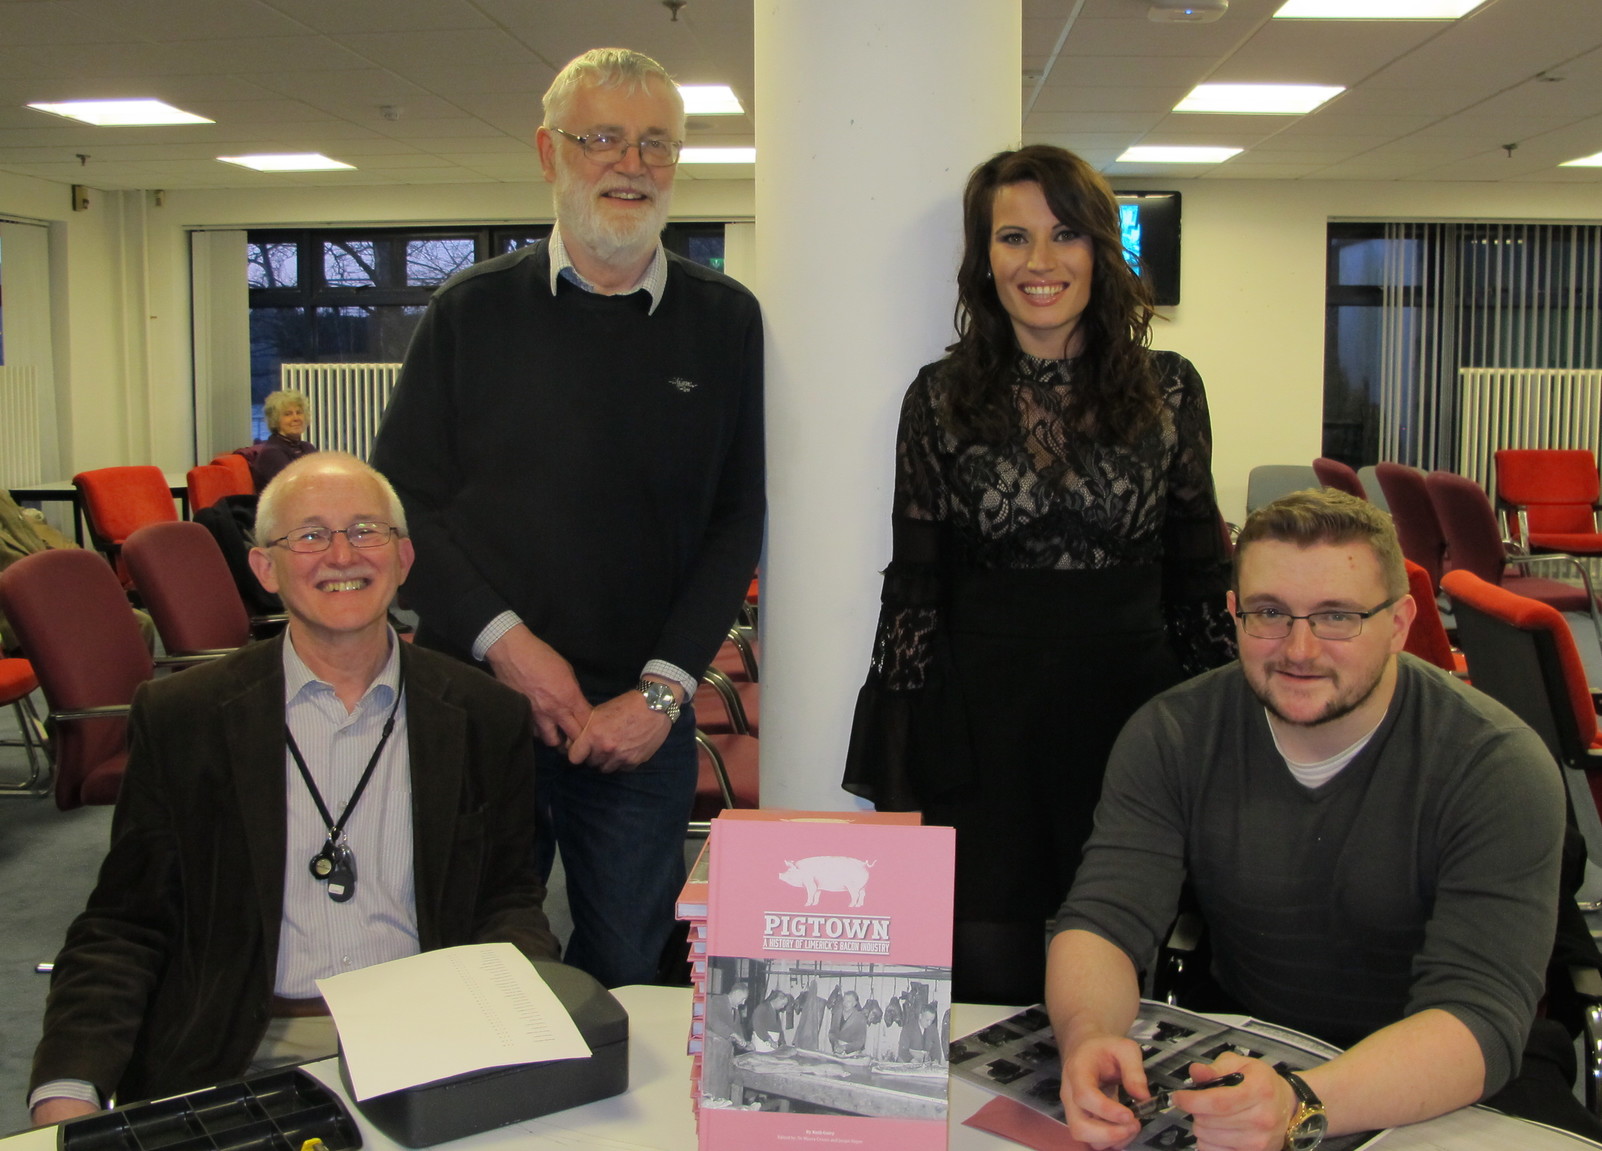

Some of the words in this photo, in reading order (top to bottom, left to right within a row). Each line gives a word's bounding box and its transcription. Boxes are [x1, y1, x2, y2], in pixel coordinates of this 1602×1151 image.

[764, 915, 890, 939] PIGTOWN
[763, 938, 768, 947] A
[769, 939, 794, 948] HISTORY
[795, 940, 804, 949] OF
[804, 940, 838, 950] LIMERICK'S
[839, 942, 860, 951] BACON
[860, 942, 890, 953] INDUSTRY
